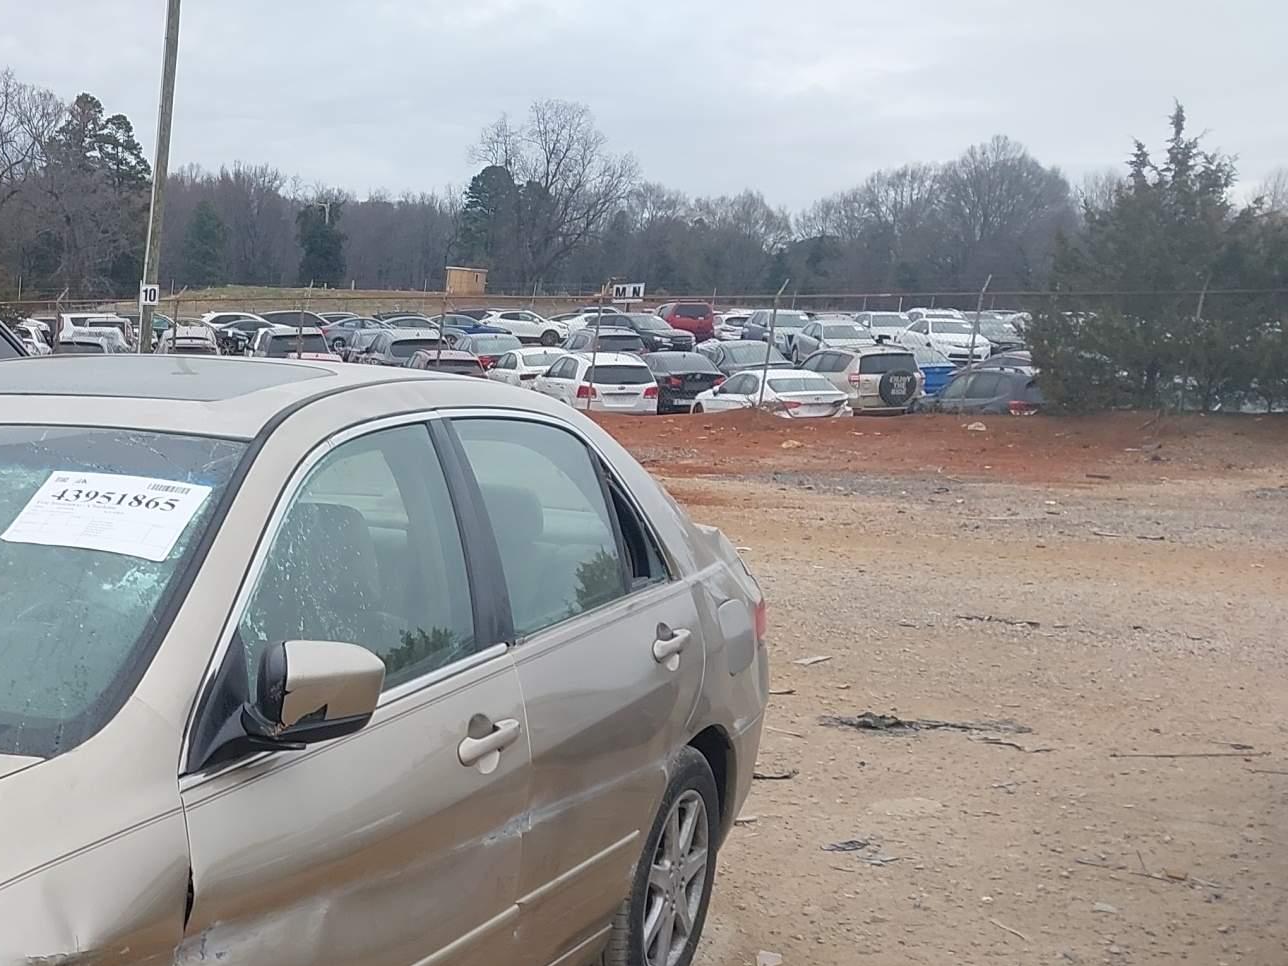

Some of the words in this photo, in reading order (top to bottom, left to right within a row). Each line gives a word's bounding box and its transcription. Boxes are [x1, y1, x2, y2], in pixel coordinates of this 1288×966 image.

[142, 288, 157, 302] 10
[615, 286, 626, 297] M
[632, 286, 641, 297] N
[51, 488, 180, 512] 43951865
